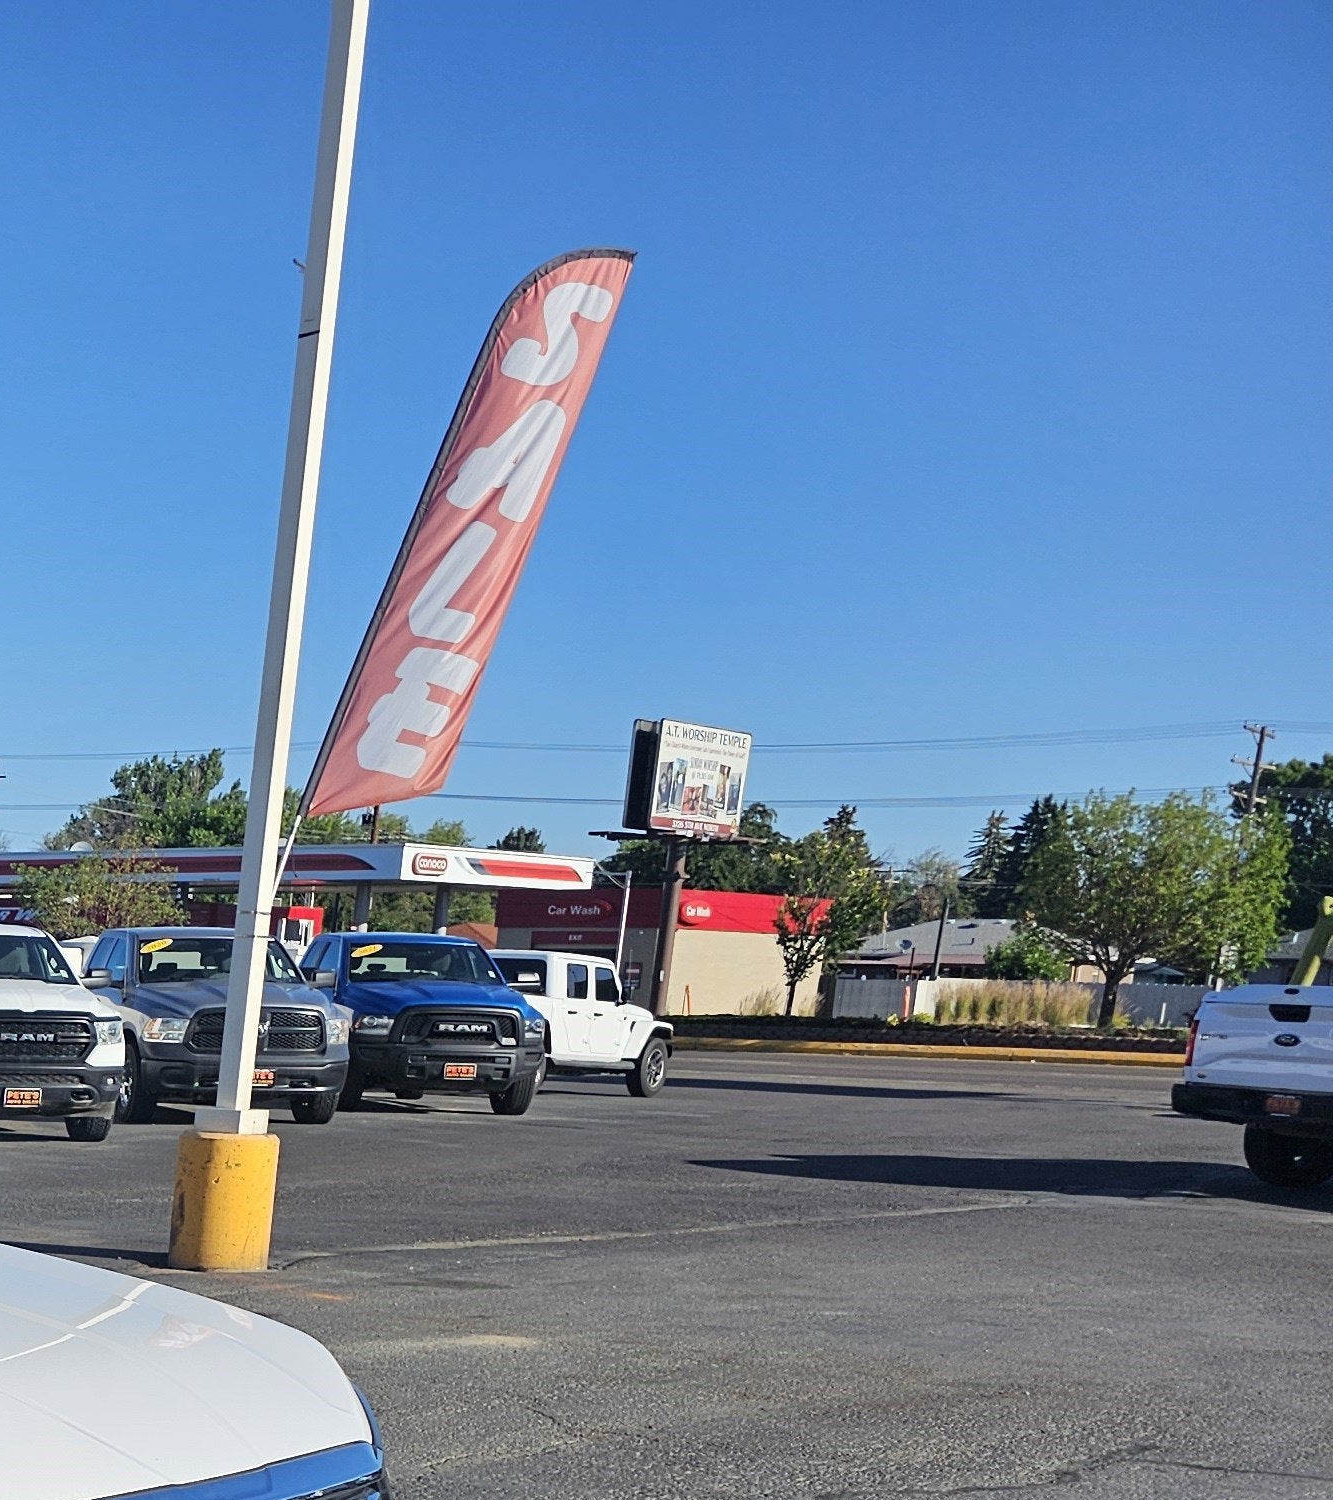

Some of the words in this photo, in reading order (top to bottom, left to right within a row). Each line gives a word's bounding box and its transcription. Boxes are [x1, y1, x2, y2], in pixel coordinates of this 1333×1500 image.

[356, 281, 614, 780] SALE
[682, 726, 718, 744] WORSHIP
[719, 733, 748, 750] TEMPLE
[547, 904, 567, 917] Car
[569, 904, 601, 917] Wash
[686, 904, 697, 918] Car
[697, 905, 712, 919] Wash
[568, 934, 583, 942] EXIT
[438, 1023, 489, 1032] RAM
[0, 1033, 55, 1042] RAM
